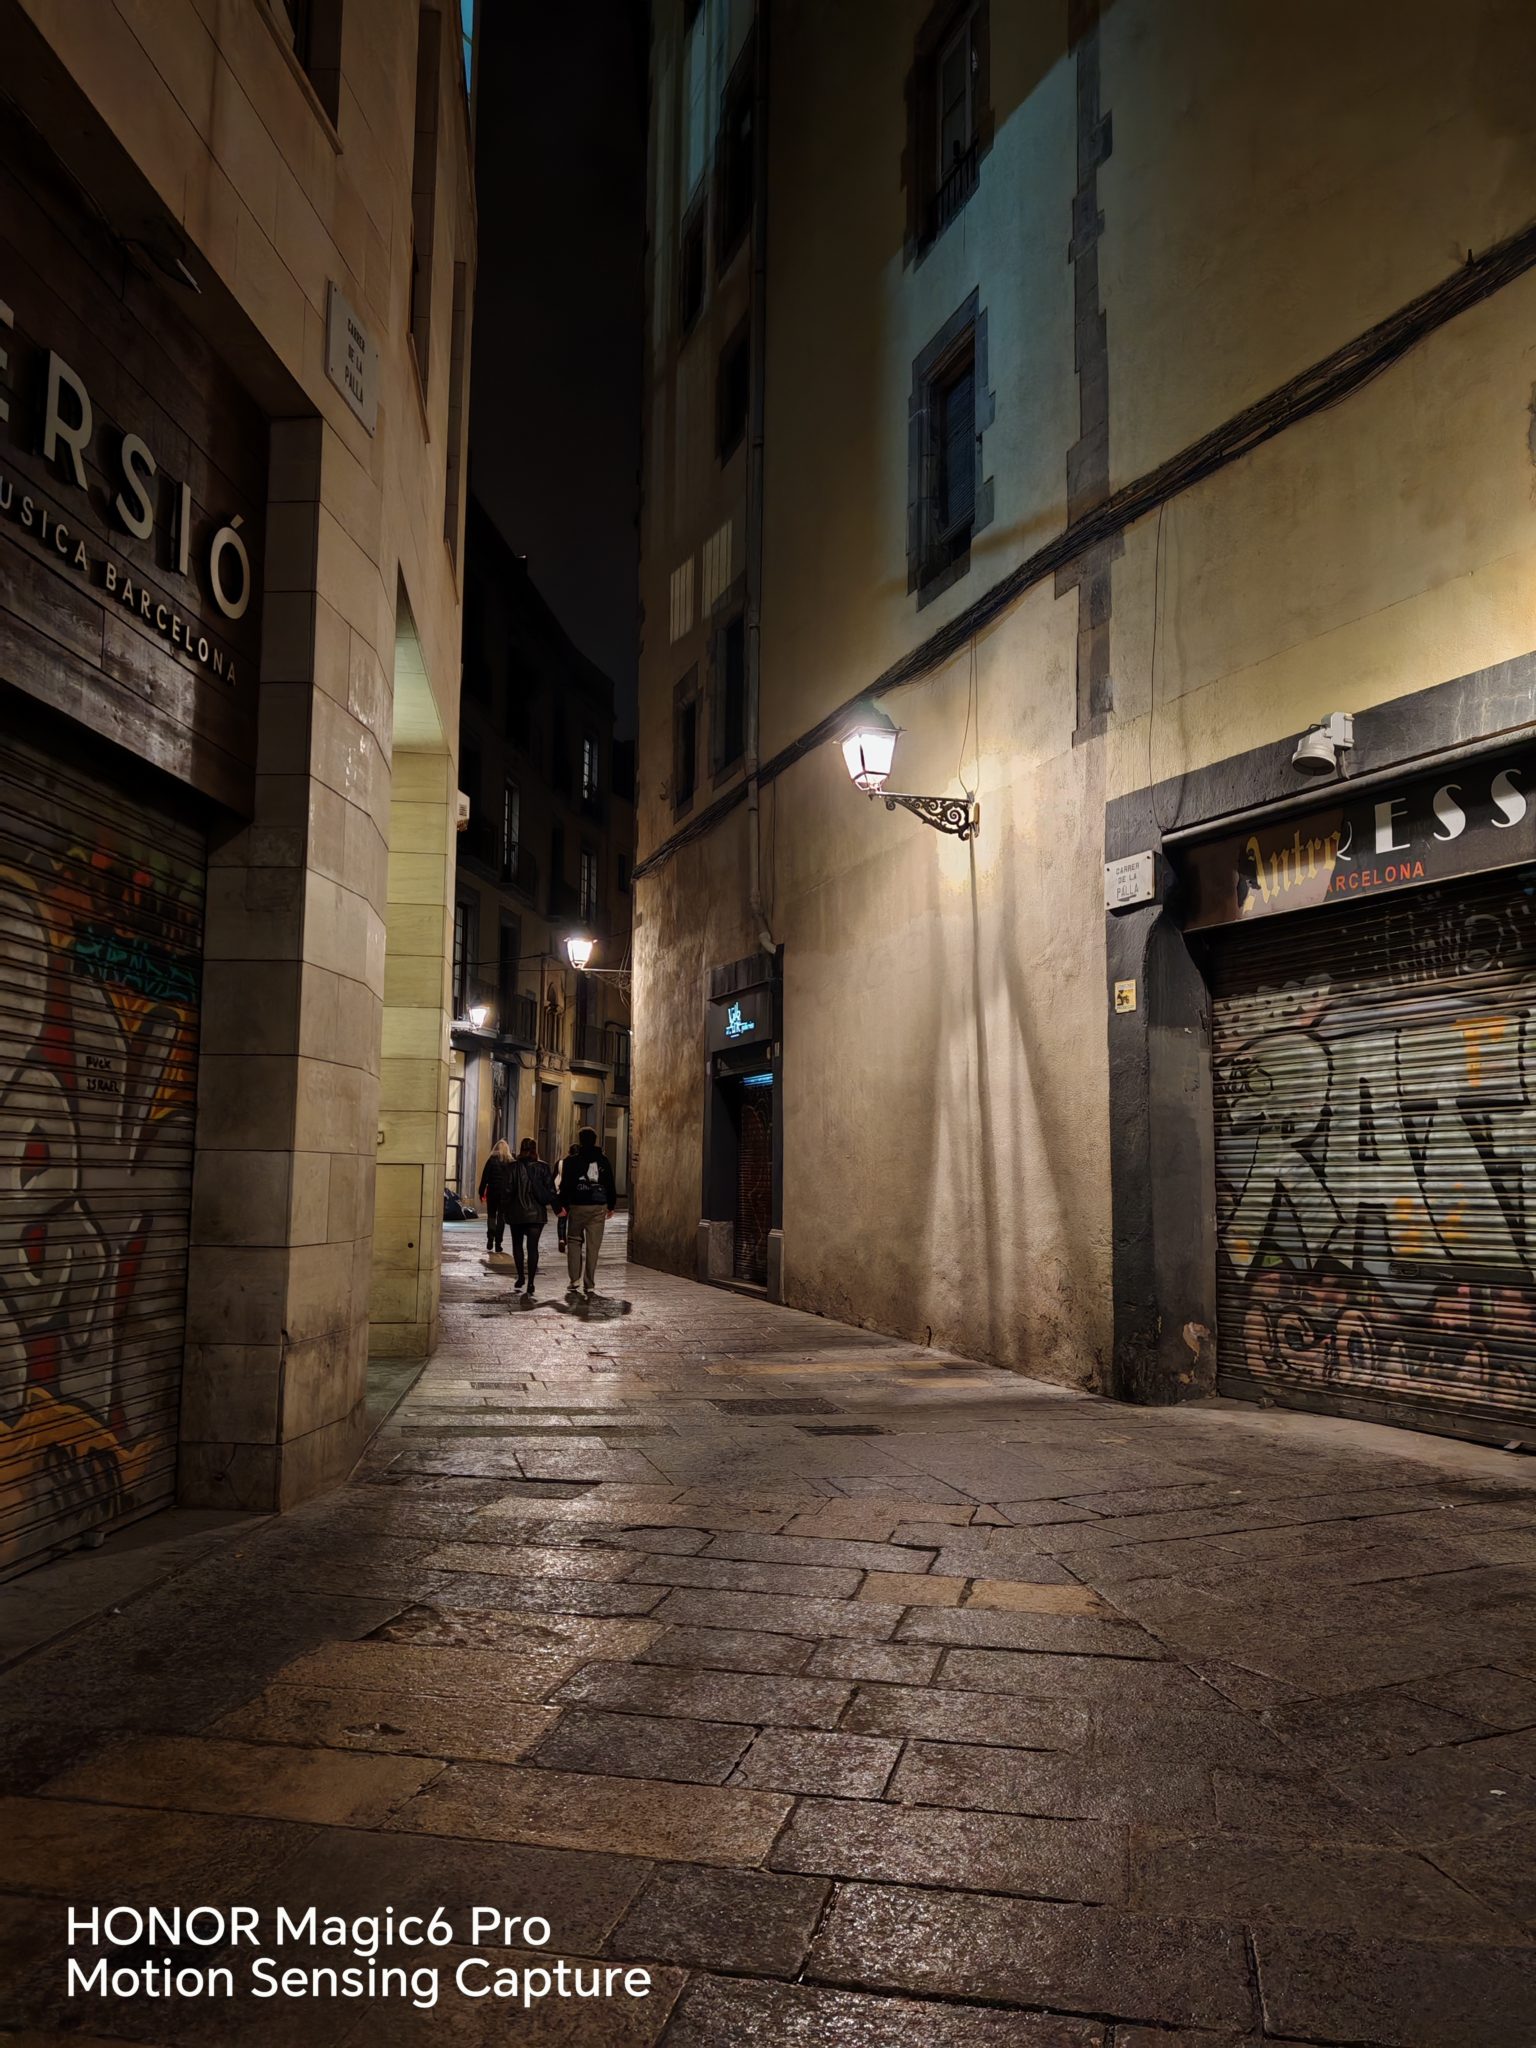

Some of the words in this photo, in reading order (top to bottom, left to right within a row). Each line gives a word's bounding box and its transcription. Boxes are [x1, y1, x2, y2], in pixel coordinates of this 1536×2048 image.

[347, 317, 366, 354] CARRER
[348, 343, 355, 364] DE
[356, 355, 363, 377] LA
[345, 364, 364, 407] PALLA
[105, 562, 237, 686] BARCELONA
[1115, 861, 1140, 875] CARRER
[1118, 875, 1127, 884] DE
[1129, 872, 1137, 881] LA
[1116, 883, 1139, 900] PALLA
[86, 1077, 121, 1093] ISRAEL
